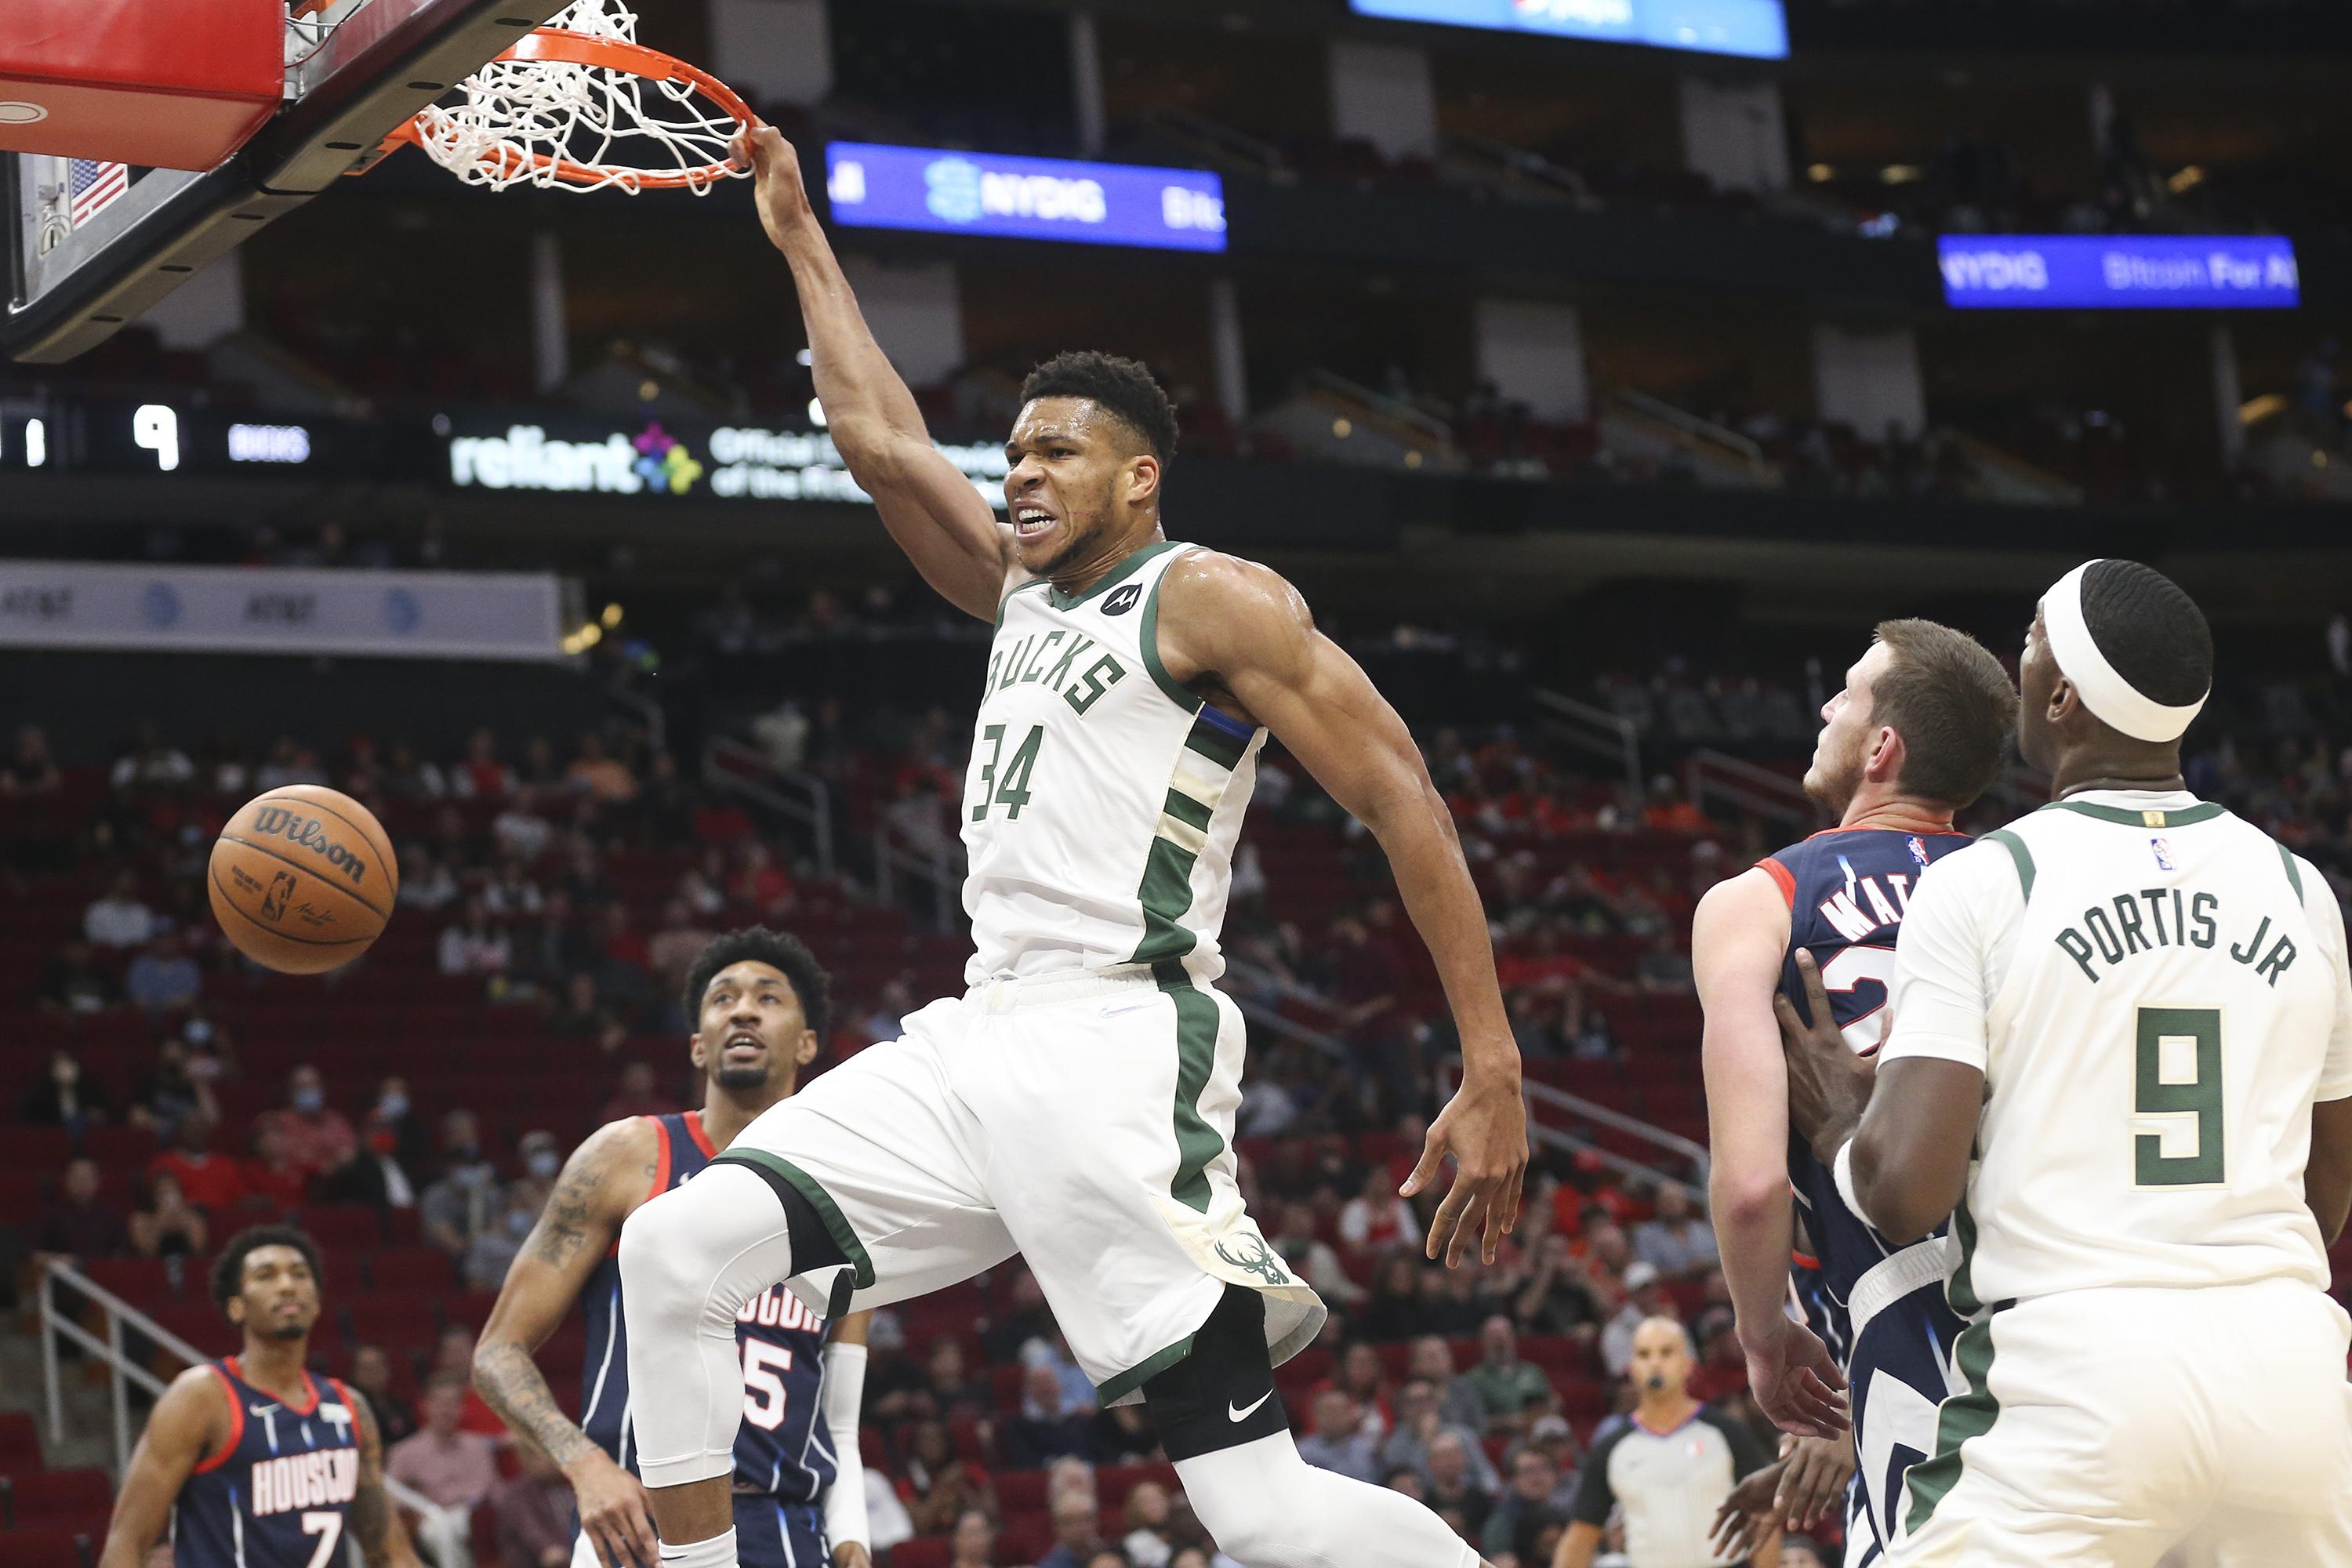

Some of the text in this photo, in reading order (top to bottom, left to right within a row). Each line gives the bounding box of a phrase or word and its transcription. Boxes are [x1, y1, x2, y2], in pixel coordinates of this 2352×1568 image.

[449, 424, 644, 495] reliant
[982, 630, 1127, 717] BUCKS
[971, 722, 1044, 823] 34
[254, 806, 366, 885] Wilson
[1818, 871, 1921, 942] MAT
[2054, 887, 2297, 989] PORTIS JR
[2132, 1004, 2230, 1189] 9
[738, 1335, 793, 1432] 5
[301, 1511, 343, 1568] 7
